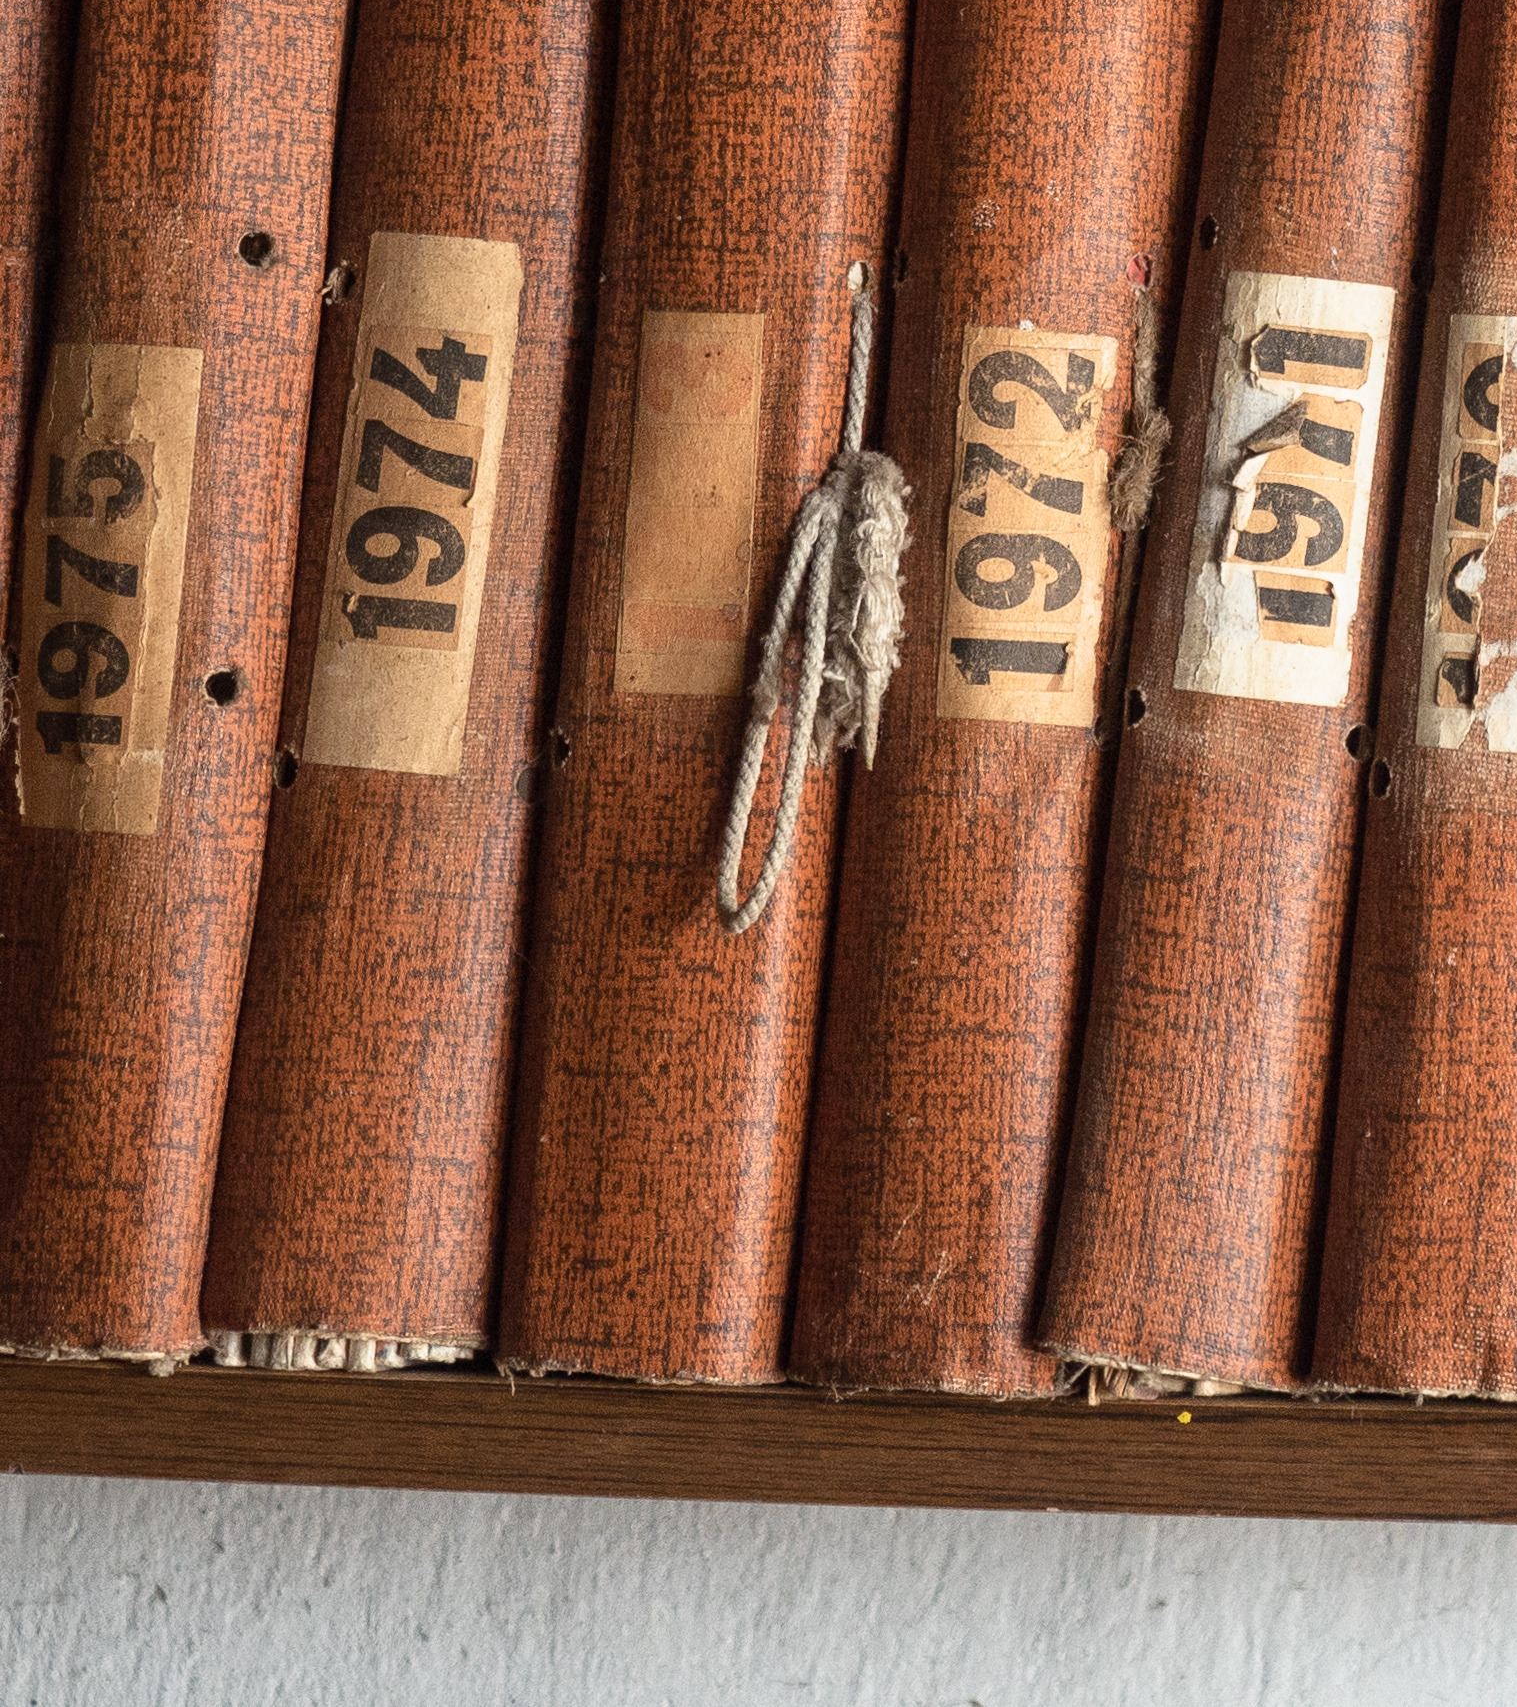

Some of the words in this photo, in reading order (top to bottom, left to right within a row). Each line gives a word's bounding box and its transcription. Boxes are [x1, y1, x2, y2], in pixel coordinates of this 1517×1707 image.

[37, 451, 147, 753] 1975
[342, 338, 488, 639] 1974
[950, 351, 1093, 685] 1972
